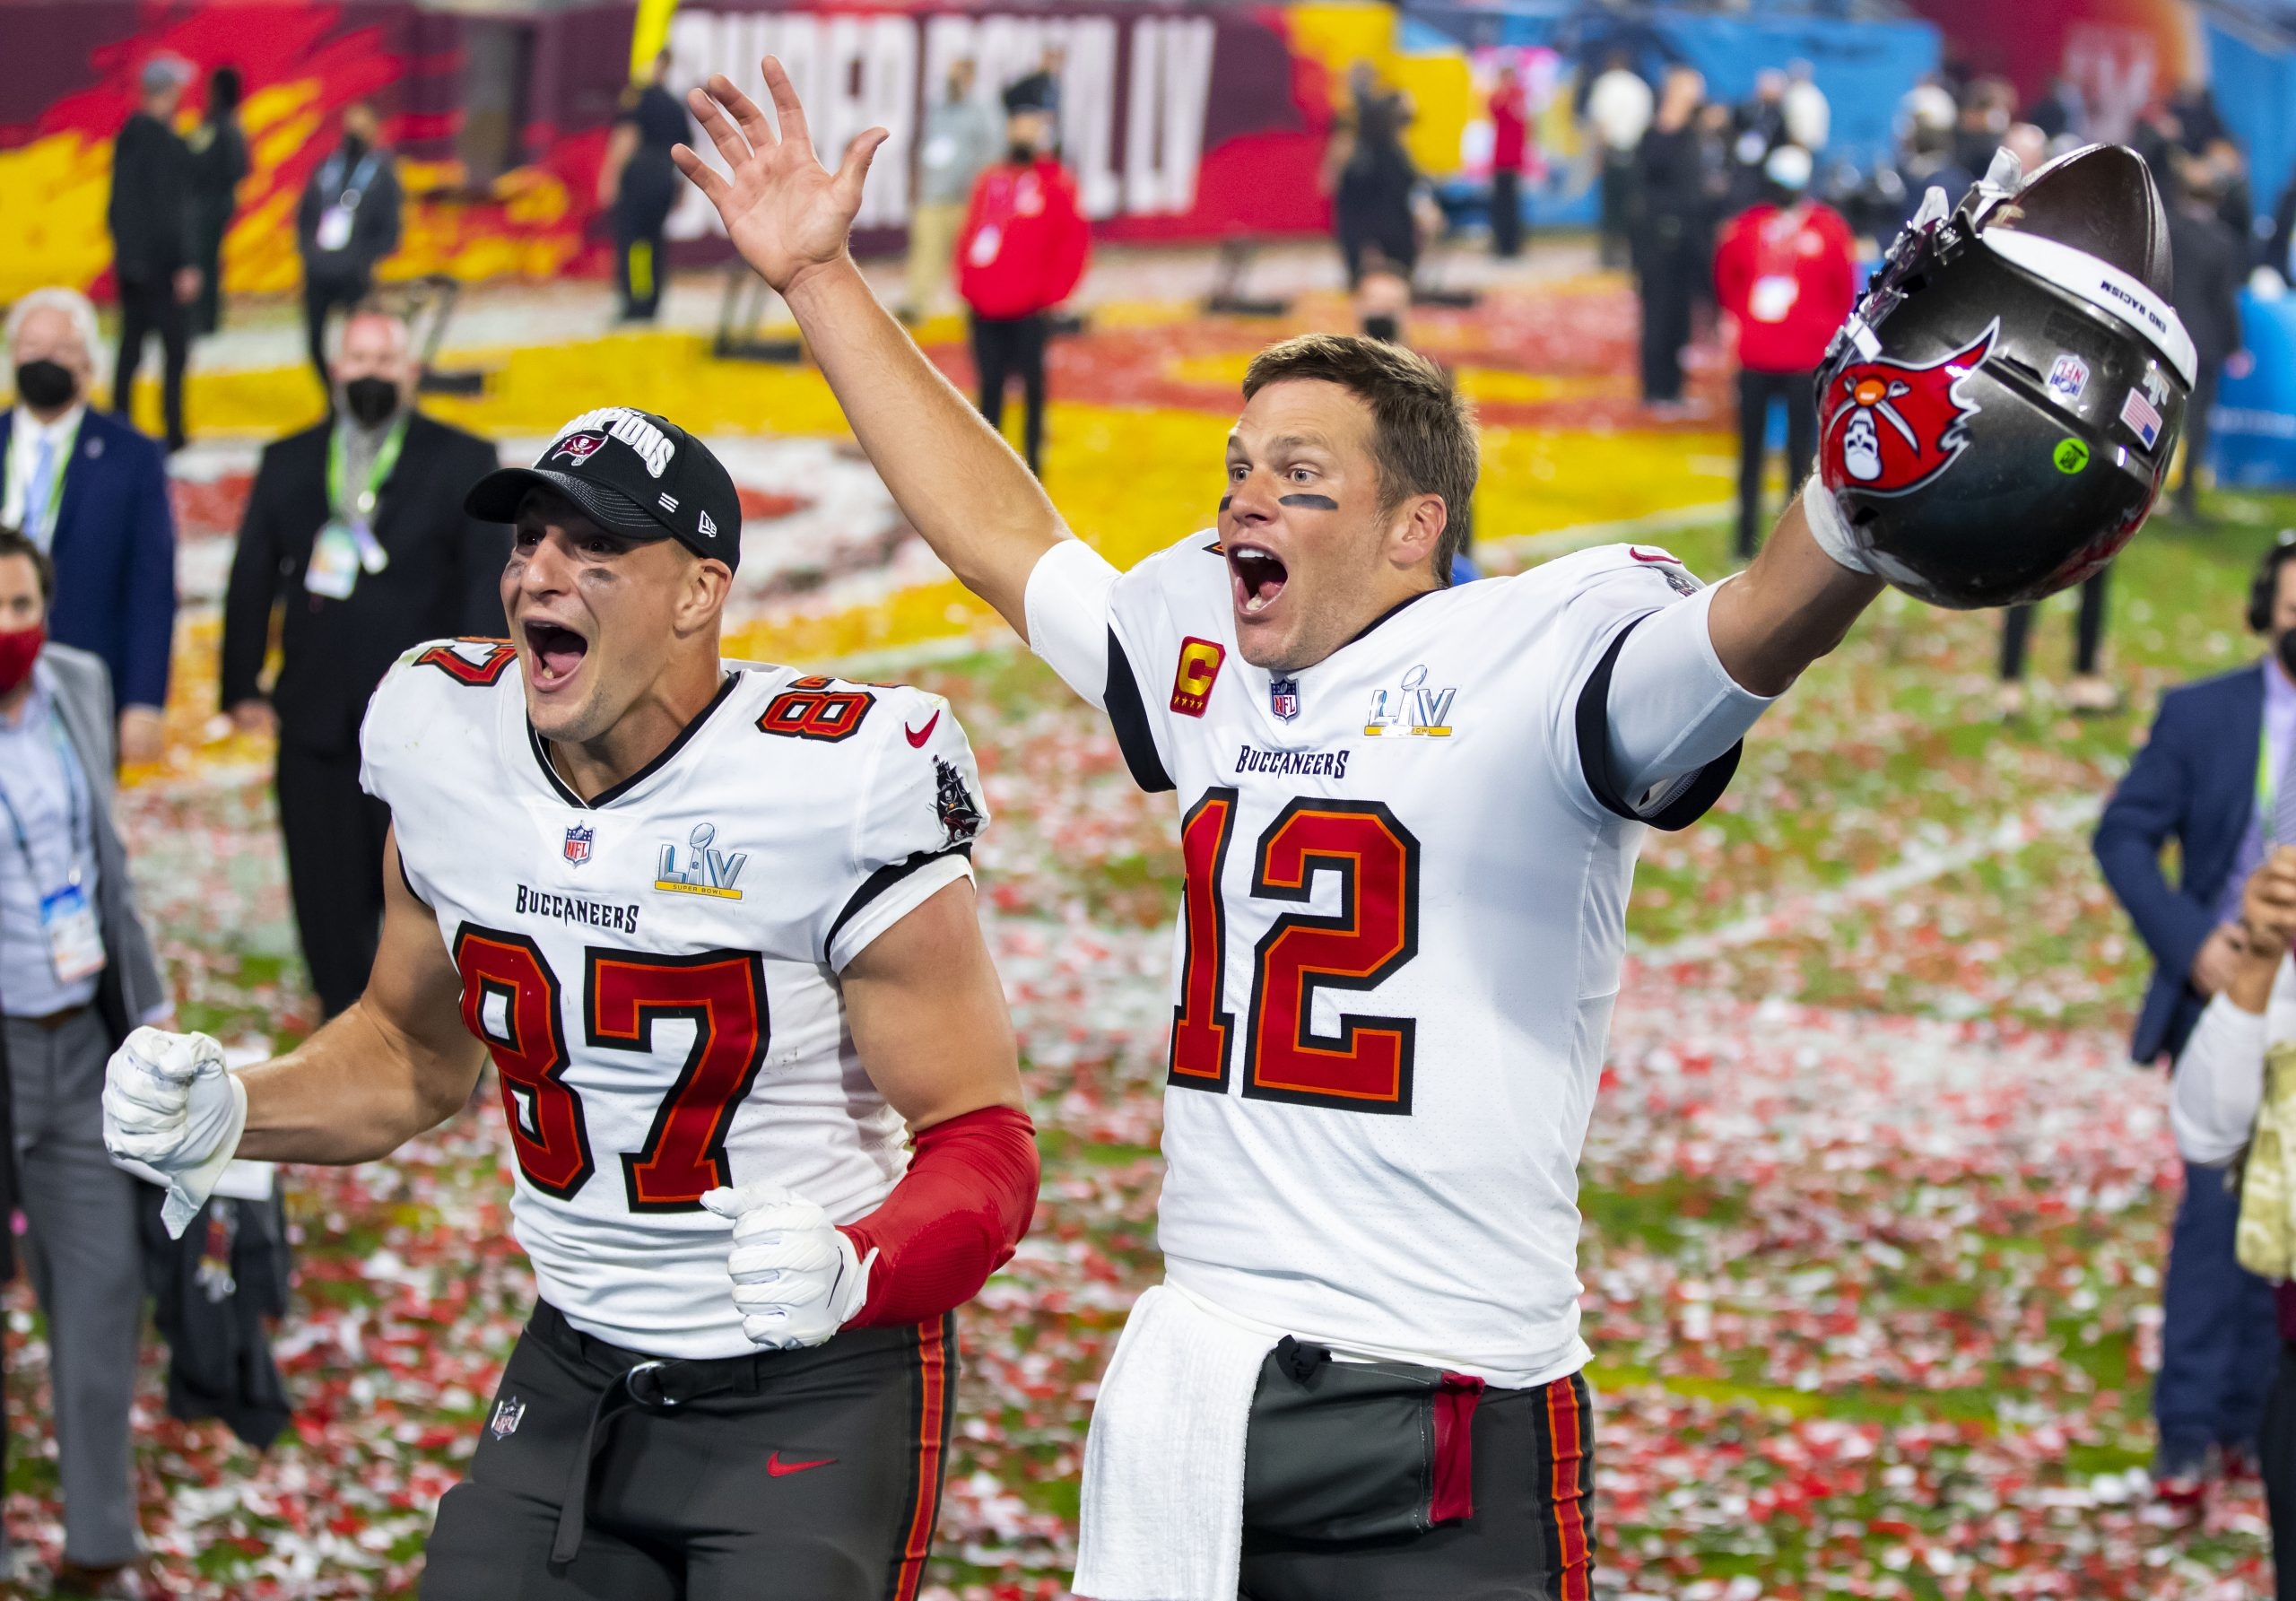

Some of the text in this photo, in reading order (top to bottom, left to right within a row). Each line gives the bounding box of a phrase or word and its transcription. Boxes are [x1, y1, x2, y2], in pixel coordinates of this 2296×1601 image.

[2100, 280, 2167, 334] END RACISM
[2058, 361, 2083, 383] NFL
[1177, 642, 1219, 696] C
[1274, 696, 1296, 716] NFL
[1235, 745, 1350, 779] BUCCANEERS
[566, 841, 587, 860] NFL
[516, 883, 639, 935] BUCCANEERS
[673, 883, 723, 896] SUPER BOWL
[1167, 786, 1421, 1116] 12
[451, 920, 771, 1214] 87
